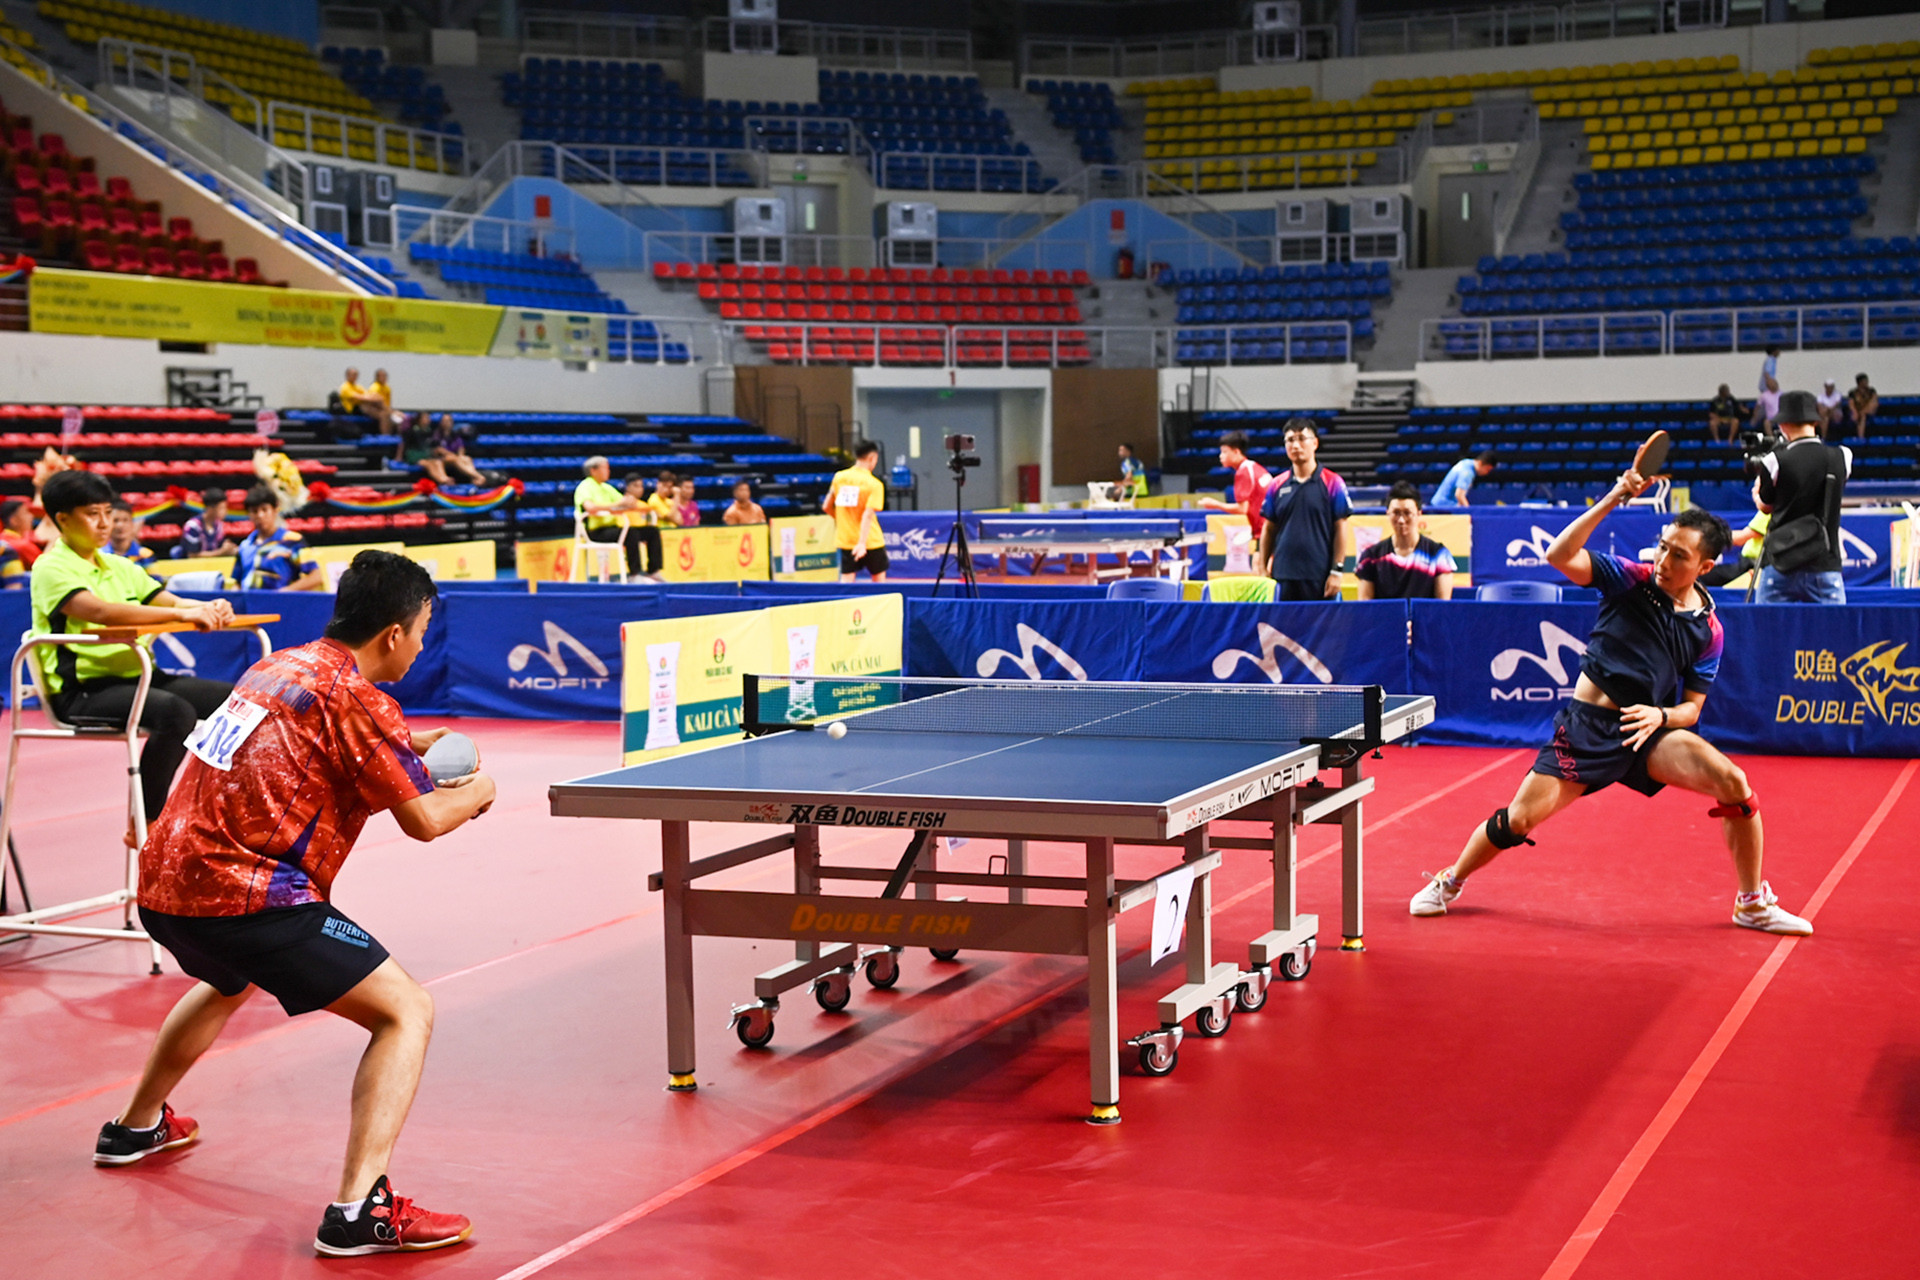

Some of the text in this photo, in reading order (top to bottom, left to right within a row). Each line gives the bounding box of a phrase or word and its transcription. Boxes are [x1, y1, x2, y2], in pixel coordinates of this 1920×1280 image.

[508, 677, 610, 690] MOFIT
[1491, 687, 1576, 701] MOF
[1775, 694, 1920, 726] DOUBLE FIS
[1260, 762, 1305, 797] MOFIT
[786, 803, 947, 828] 双鱼 DOUBLE FISH
[790, 903, 972, 935] DOUBLE FISH
